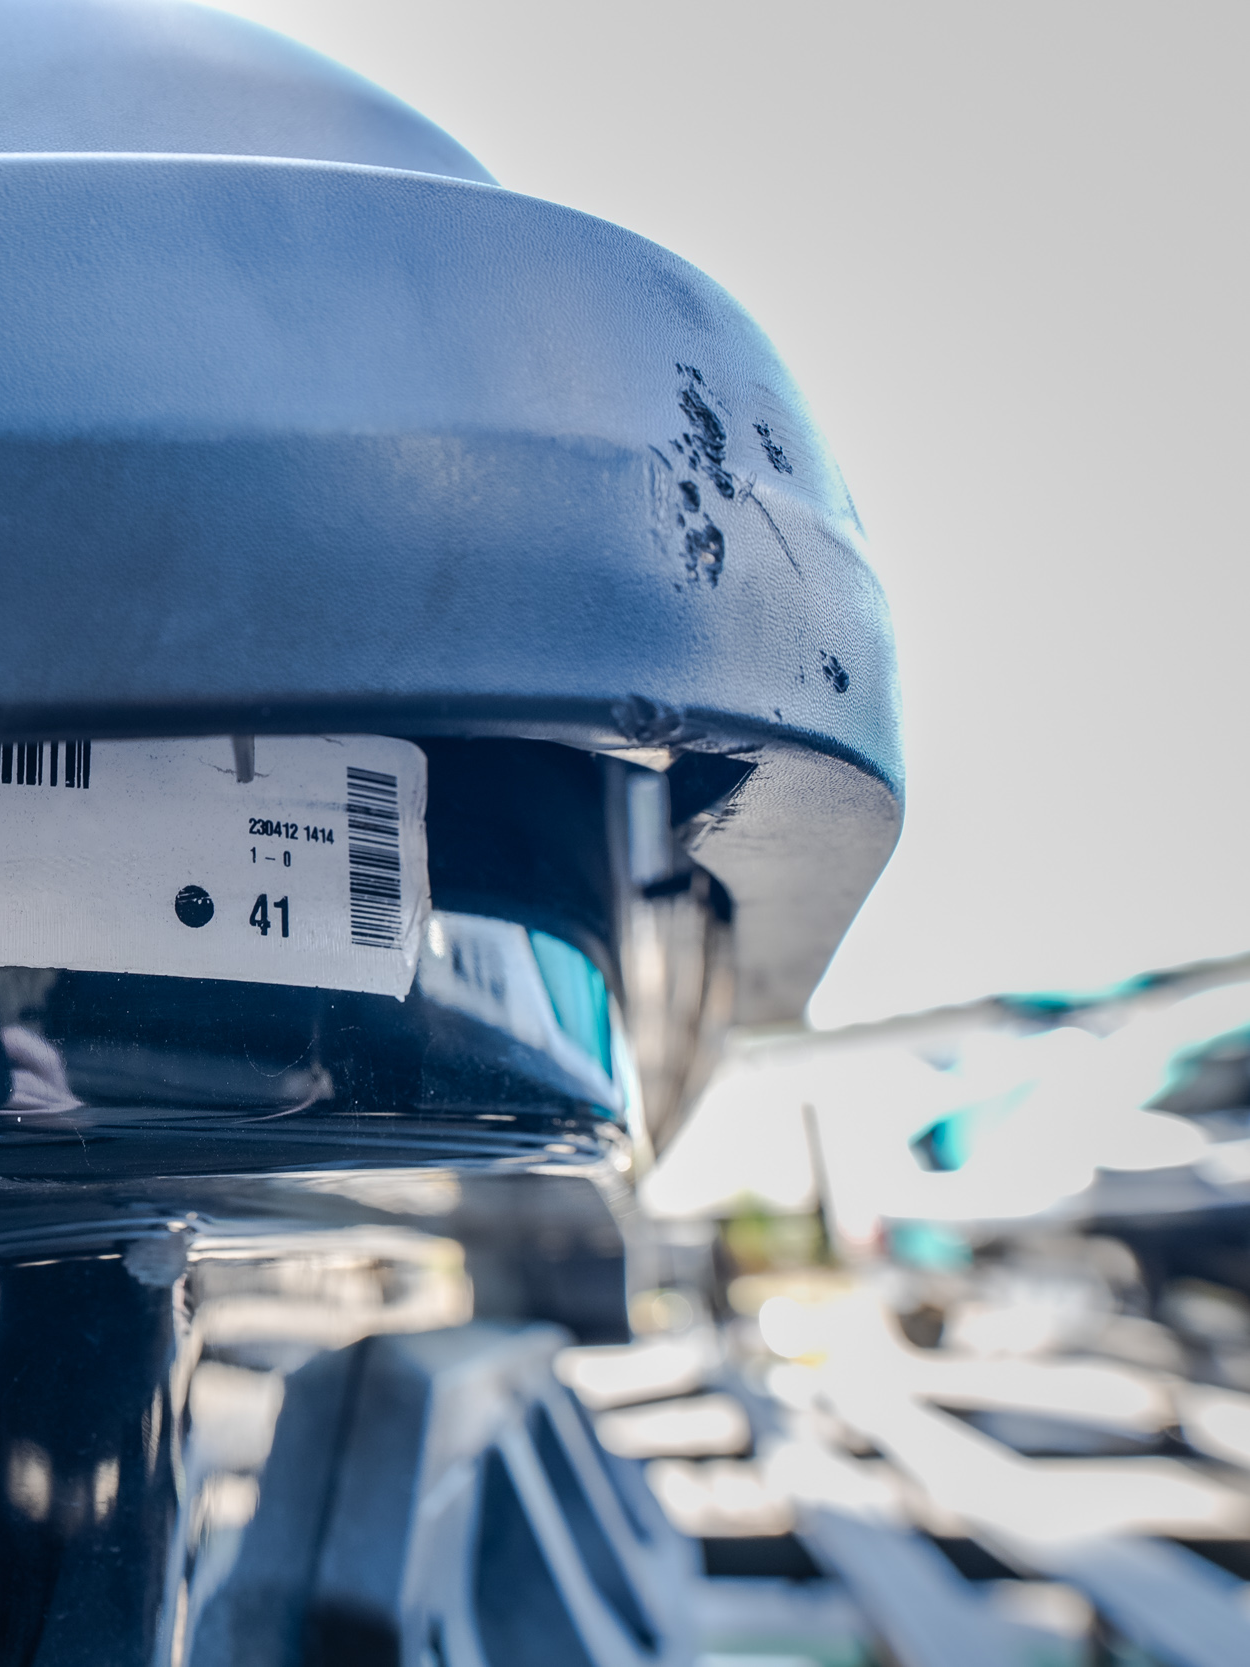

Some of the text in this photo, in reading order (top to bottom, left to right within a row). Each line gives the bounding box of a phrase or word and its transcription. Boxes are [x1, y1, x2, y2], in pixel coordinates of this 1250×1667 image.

[249, 818, 334, 845] 230412 1414
[249, 893, 289, 938] 41
